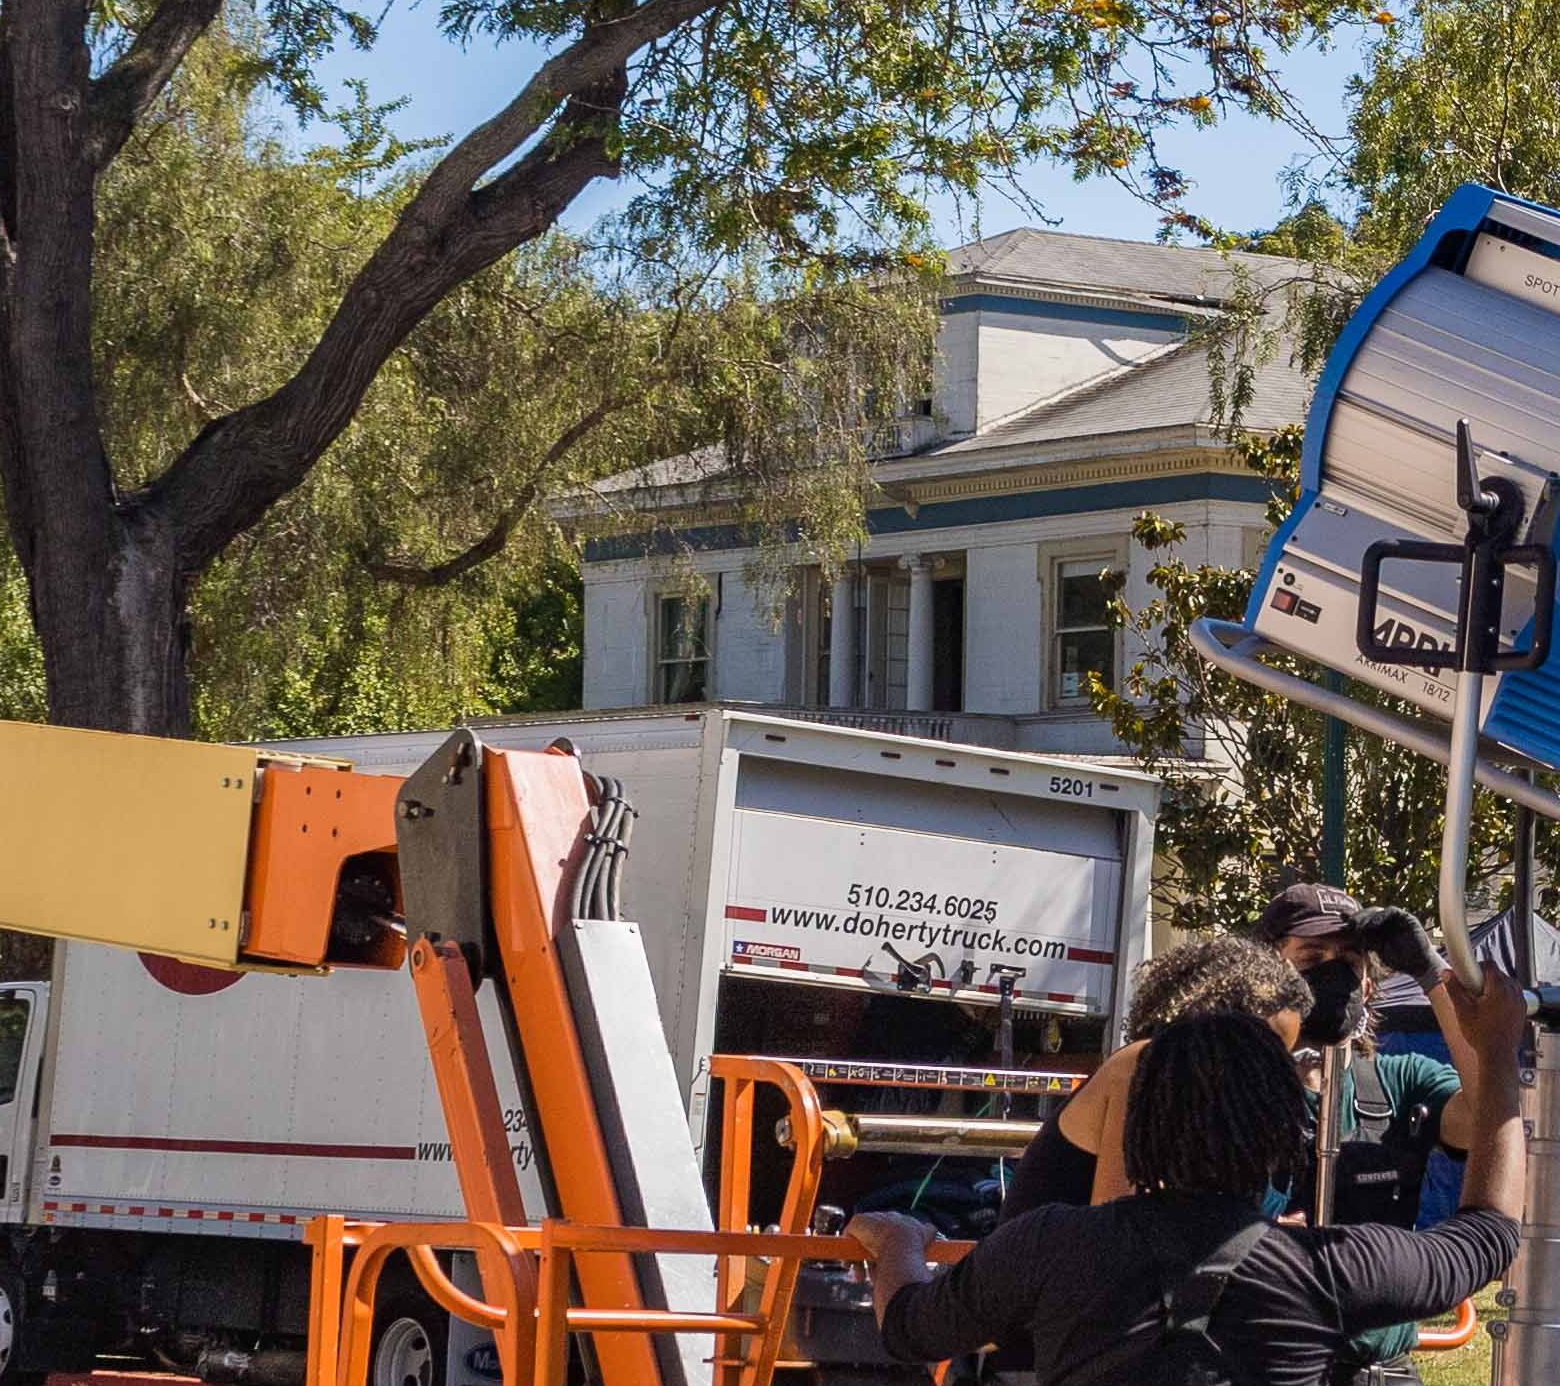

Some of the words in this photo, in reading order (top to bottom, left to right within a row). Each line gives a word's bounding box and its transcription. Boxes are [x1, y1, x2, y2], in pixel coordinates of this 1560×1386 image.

[1524, 274, 1560, 297] SPOT
[1422, 682, 1450, 702] 18/12
[1049, 776, 1093, 798] 5201
[847, 883, 998, 922] 510.234.6025
[770, 906, 1066, 960] www.dohertytruck.com
[744, 943, 800, 960] MORGAN
